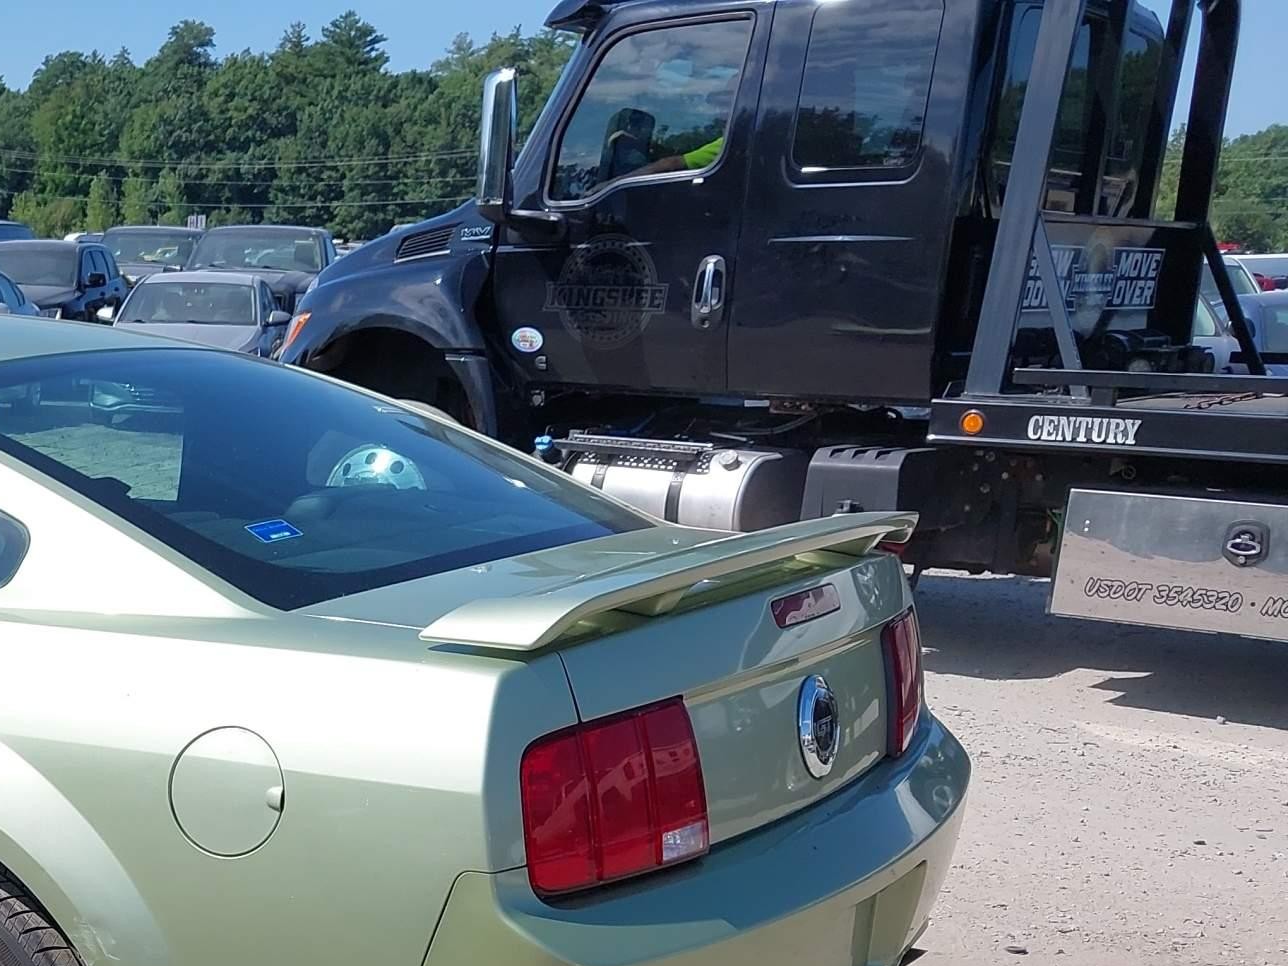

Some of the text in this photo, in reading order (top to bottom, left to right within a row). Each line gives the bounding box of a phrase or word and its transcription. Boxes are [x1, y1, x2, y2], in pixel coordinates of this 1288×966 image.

[1117, 252, 1161, 278] MOVE
[1112, 280, 1155, 305] OVER
[1027, 414, 1143, 445] CENTURY
[1084, 577, 1153, 602] USDOT
[1153, 584, 1244, 613] 3545320
